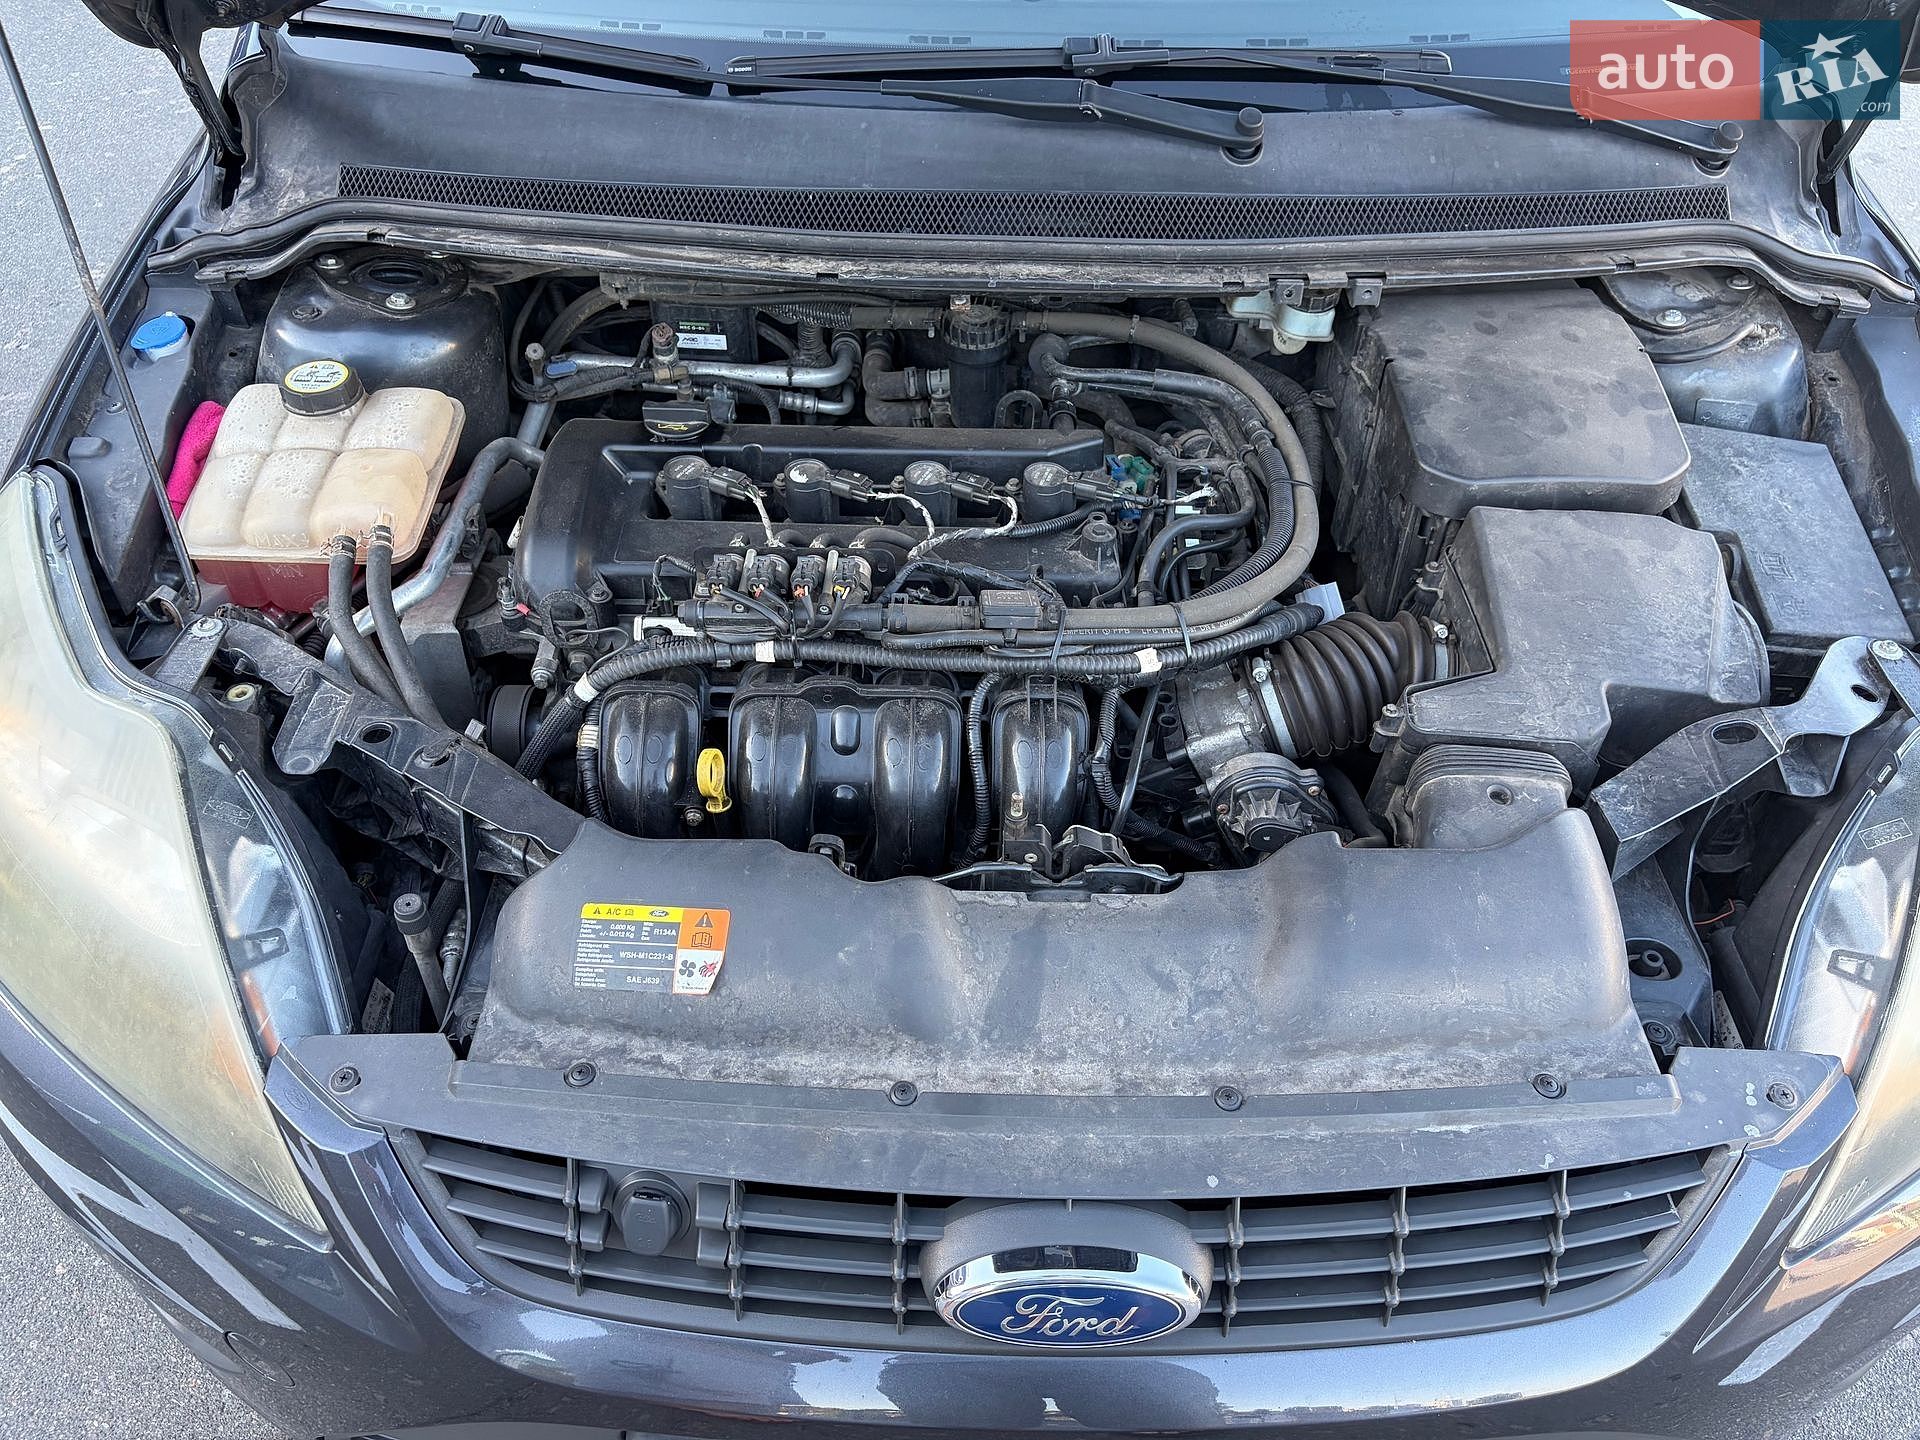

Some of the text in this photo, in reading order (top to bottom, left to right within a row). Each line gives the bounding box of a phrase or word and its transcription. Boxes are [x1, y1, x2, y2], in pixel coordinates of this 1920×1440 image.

[1060, 627, 1100, 635] EMPERIT
[606, 907, 621, 916] A/C
[654, 928, 677, 936] R134A
[643, 976, 660, 984] J639
[1000, 1294, 1138, 1337] Ford
